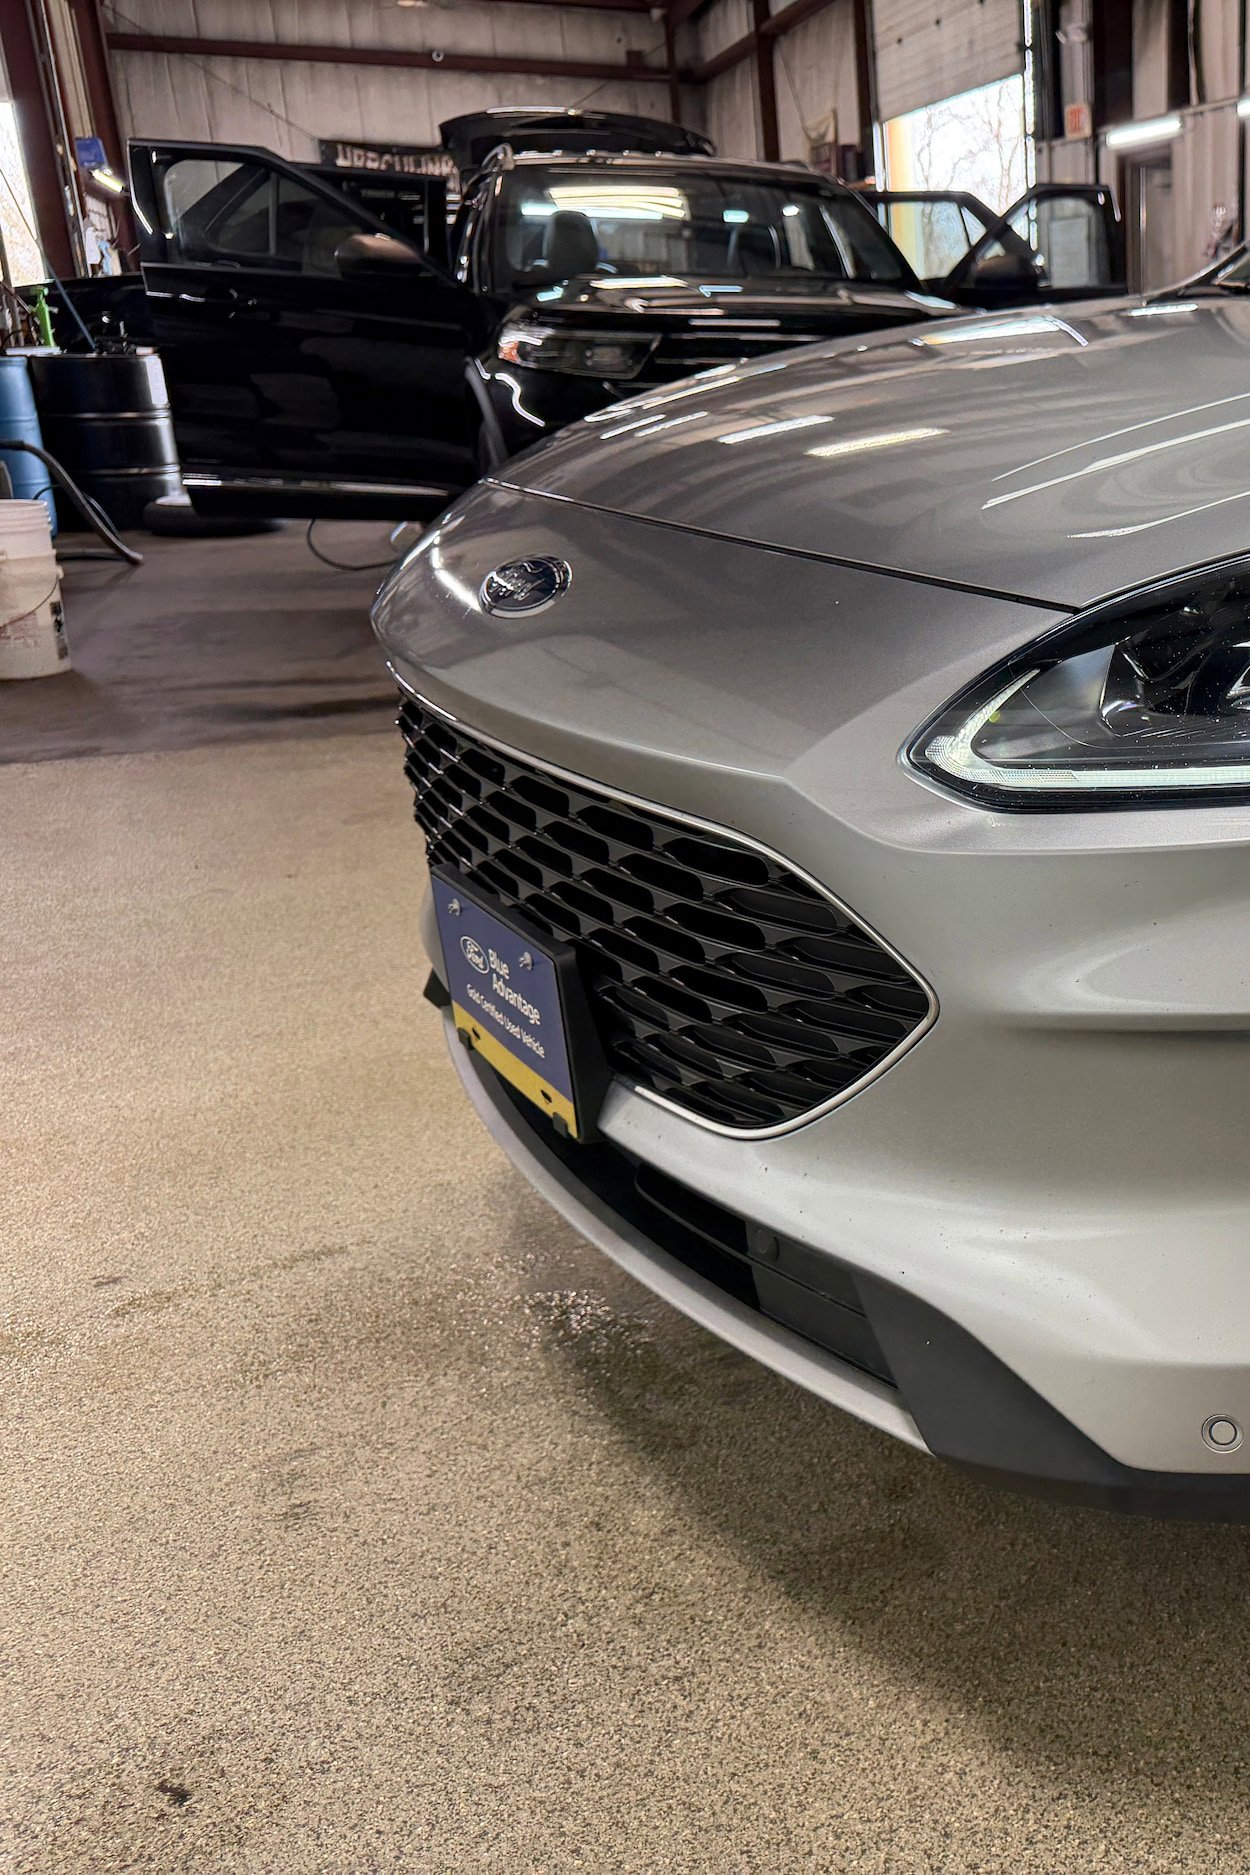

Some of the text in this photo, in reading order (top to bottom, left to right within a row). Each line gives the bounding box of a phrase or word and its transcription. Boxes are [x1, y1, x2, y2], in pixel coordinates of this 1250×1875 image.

[488, 948, 510, 980] Blue
[466, 983, 546, 1059] Gold Certified Used Vehicle
[492, 972, 541, 1025] Advantage
